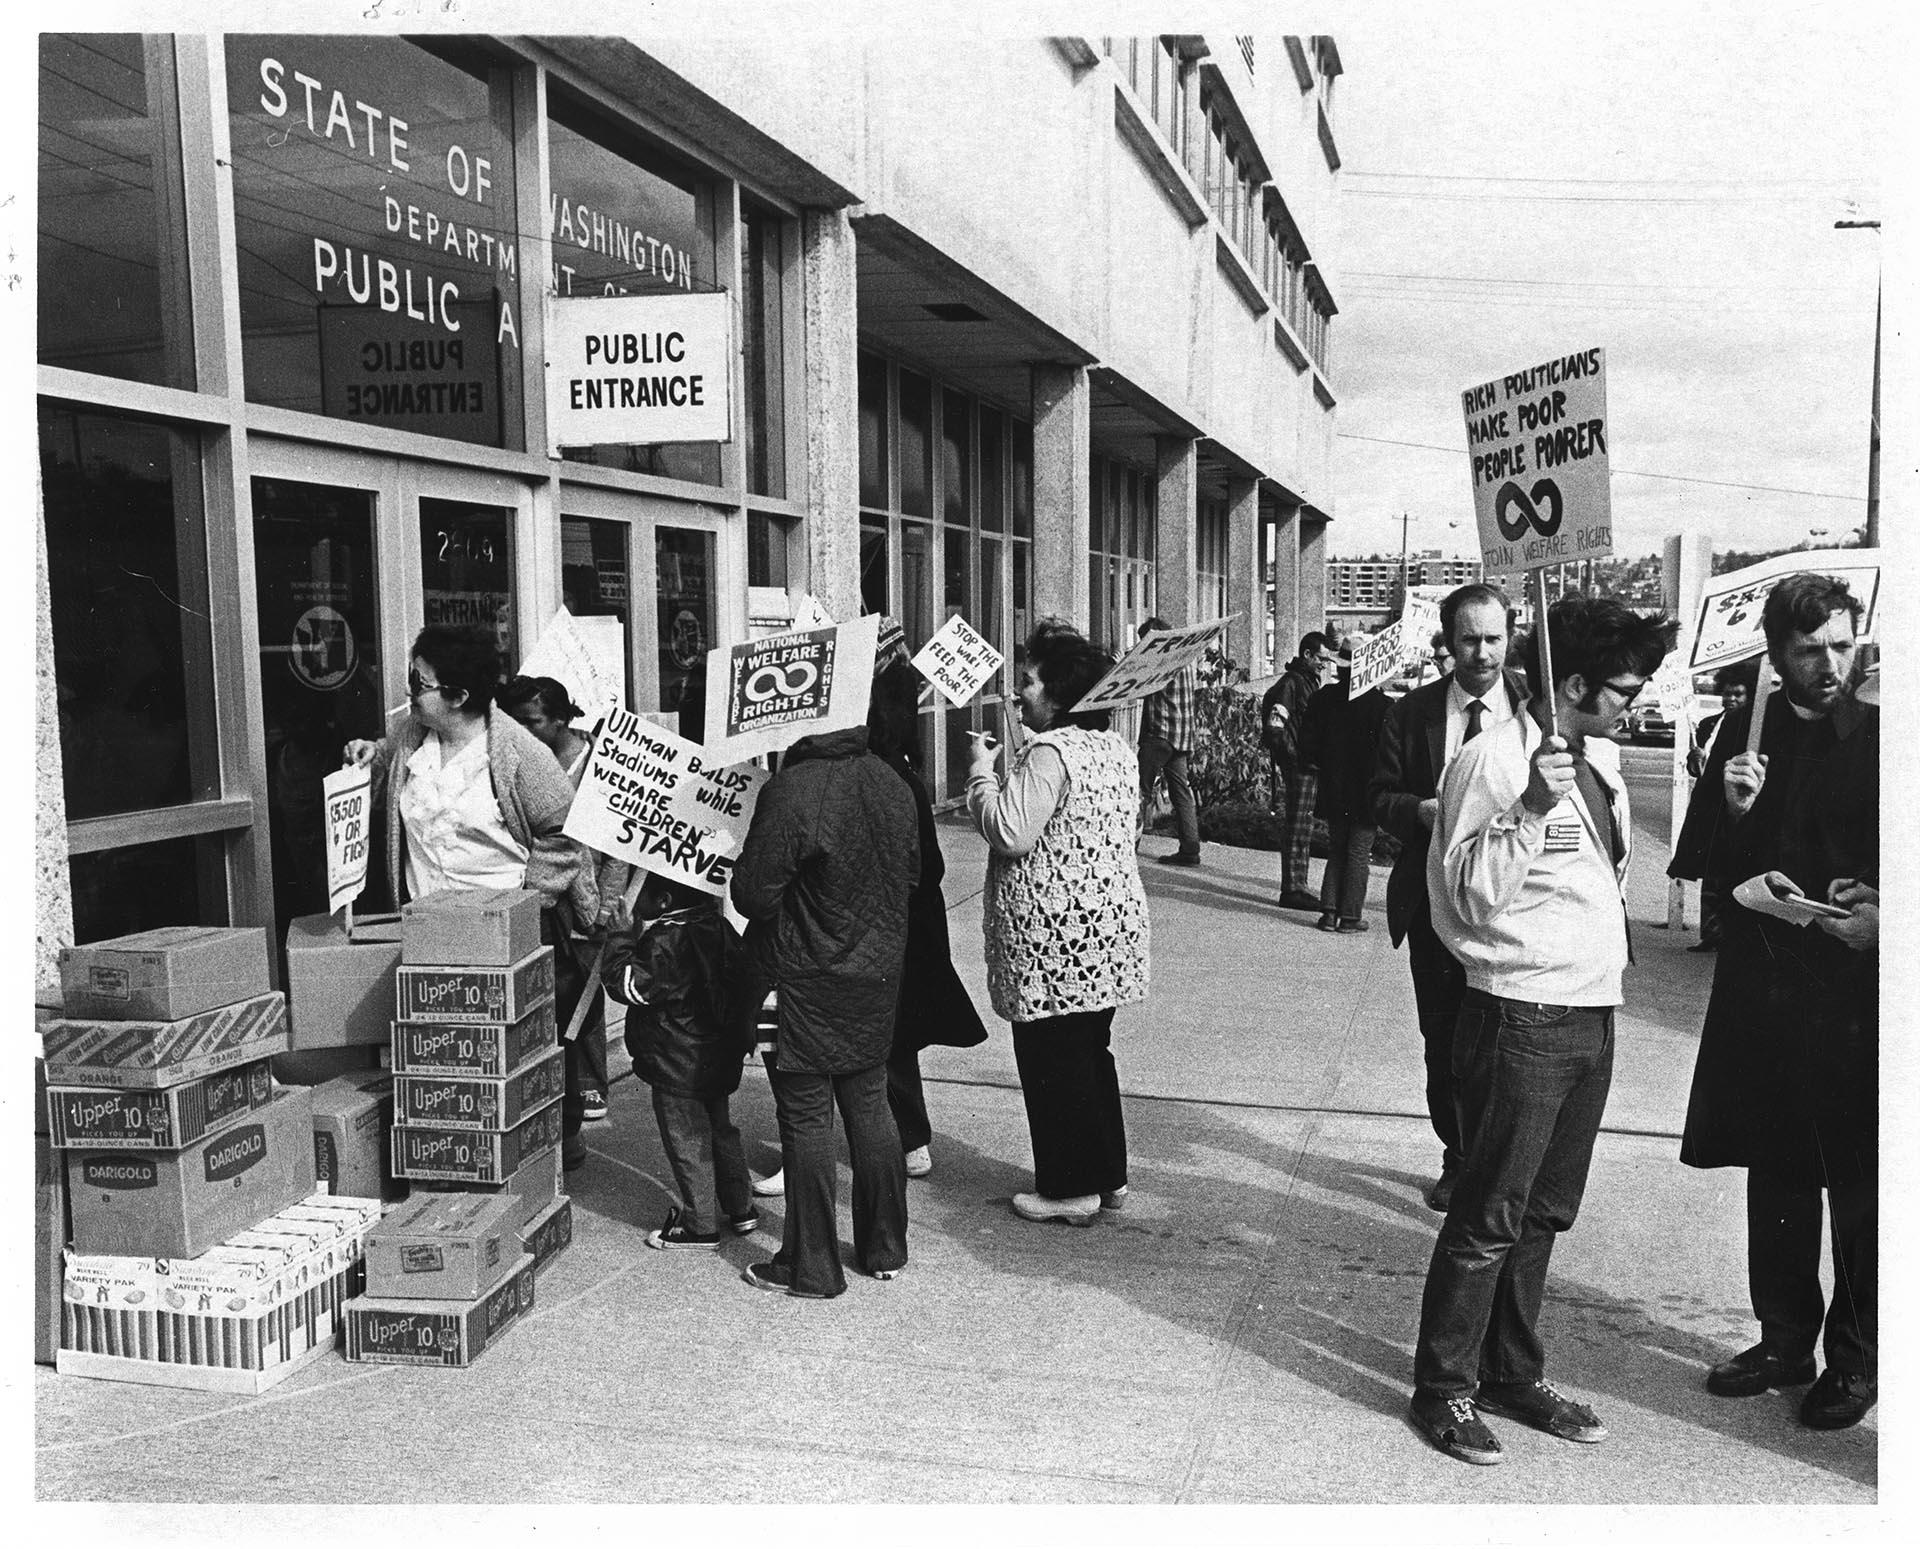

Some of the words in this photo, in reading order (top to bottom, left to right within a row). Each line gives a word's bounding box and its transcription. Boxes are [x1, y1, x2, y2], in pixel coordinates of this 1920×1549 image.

[260, 58, 409, 172] STATE
[447, 145, 491, 202] OF
[314, 238, 460, 332] PUBLIC
[585, 332, 685, 365] PUBLIC
[570, 375, 704, 410] ENTRANCE
[1464, 382, 1496, 415] RICH
[1504, 347, 1601, 400] POLITICIANS
[1468, 410, 1510, 446] MAKE
[1518, 390, 1567, 432] POOR
[1473, 443, 1526, 487] PEOPLE
[1535, 418, 1606, 470] POORER
[1484, 546, 1513, 568] JOIN
[1522, 533, 1569, 561] WELFARE
[1576, 526, 1612, 551] RIGHTS
[754, 633, 811, 653] NATIONAL
[952, 623, 978, 646] STOP
[978, 645, 999, 668] THE
[957, 644, 981, 668] WAR!
[1140, 626, 1220, 655] FRAUD
[1353, 620, 1402, 660] CUTBACKS
[748, 644, 821, 670] WELFARE
[928, 641, 955, 666] FEED
[957, 667, 979, 689] THE
[819, 640, 834, 707] RIGHTS
[933, 667, 966, 695] POOR!
[731, 656, 745, 725] WELFARE
[743, 693, 814, 719] RIGHTS
[739, 707, 817, 732] ORGANIZATION
[594, 762, 673, 811] WELFARE
[345, 819, 361, 841] OR
[609, 793, 703, 846] CHILDREN
[343, 837, 368, 865] FIGH
[616, 820, 736, 885] STARVE
[419, 976, 463, 1004] Upper
[464, 985, 480, 1005] 10
[209, 1048, 242, 1066] ORANGE
[413, 1030, 457, 1057] Upper
[457, 1039, 473, 1058] 10
[80, 1073, 122, 1084] ORANGE
[208, 1073, 232, 1111] Upper
[233, 1077, 243, 1101] 10
[70, 1096, 120, 1128] Upper
[123, 1106, 141, 1128] 10
[415, 1084, 457, 1111] Upper
[458, 1094, 474, 1112] 10
[209, 1134, 262, 1171] DARIGOLD
[317, 1136, 330, 1180] DARIGO
[412, 1135, 454, 1161] Upper
[454, 1145, 470, 1164] 10
[89, 1166, 152, 1180] DARIGOLD
[71, 1275, 111, 1285] VARIETY
[114, 1279, 136, 1287] PAK
[172, 1281, 213, 1292] VARIETY
[215, 1286, 237, 1294] PAK
[369, 1315, 417, 1344] Upper
[417, 1326, 433, 1347] 10
